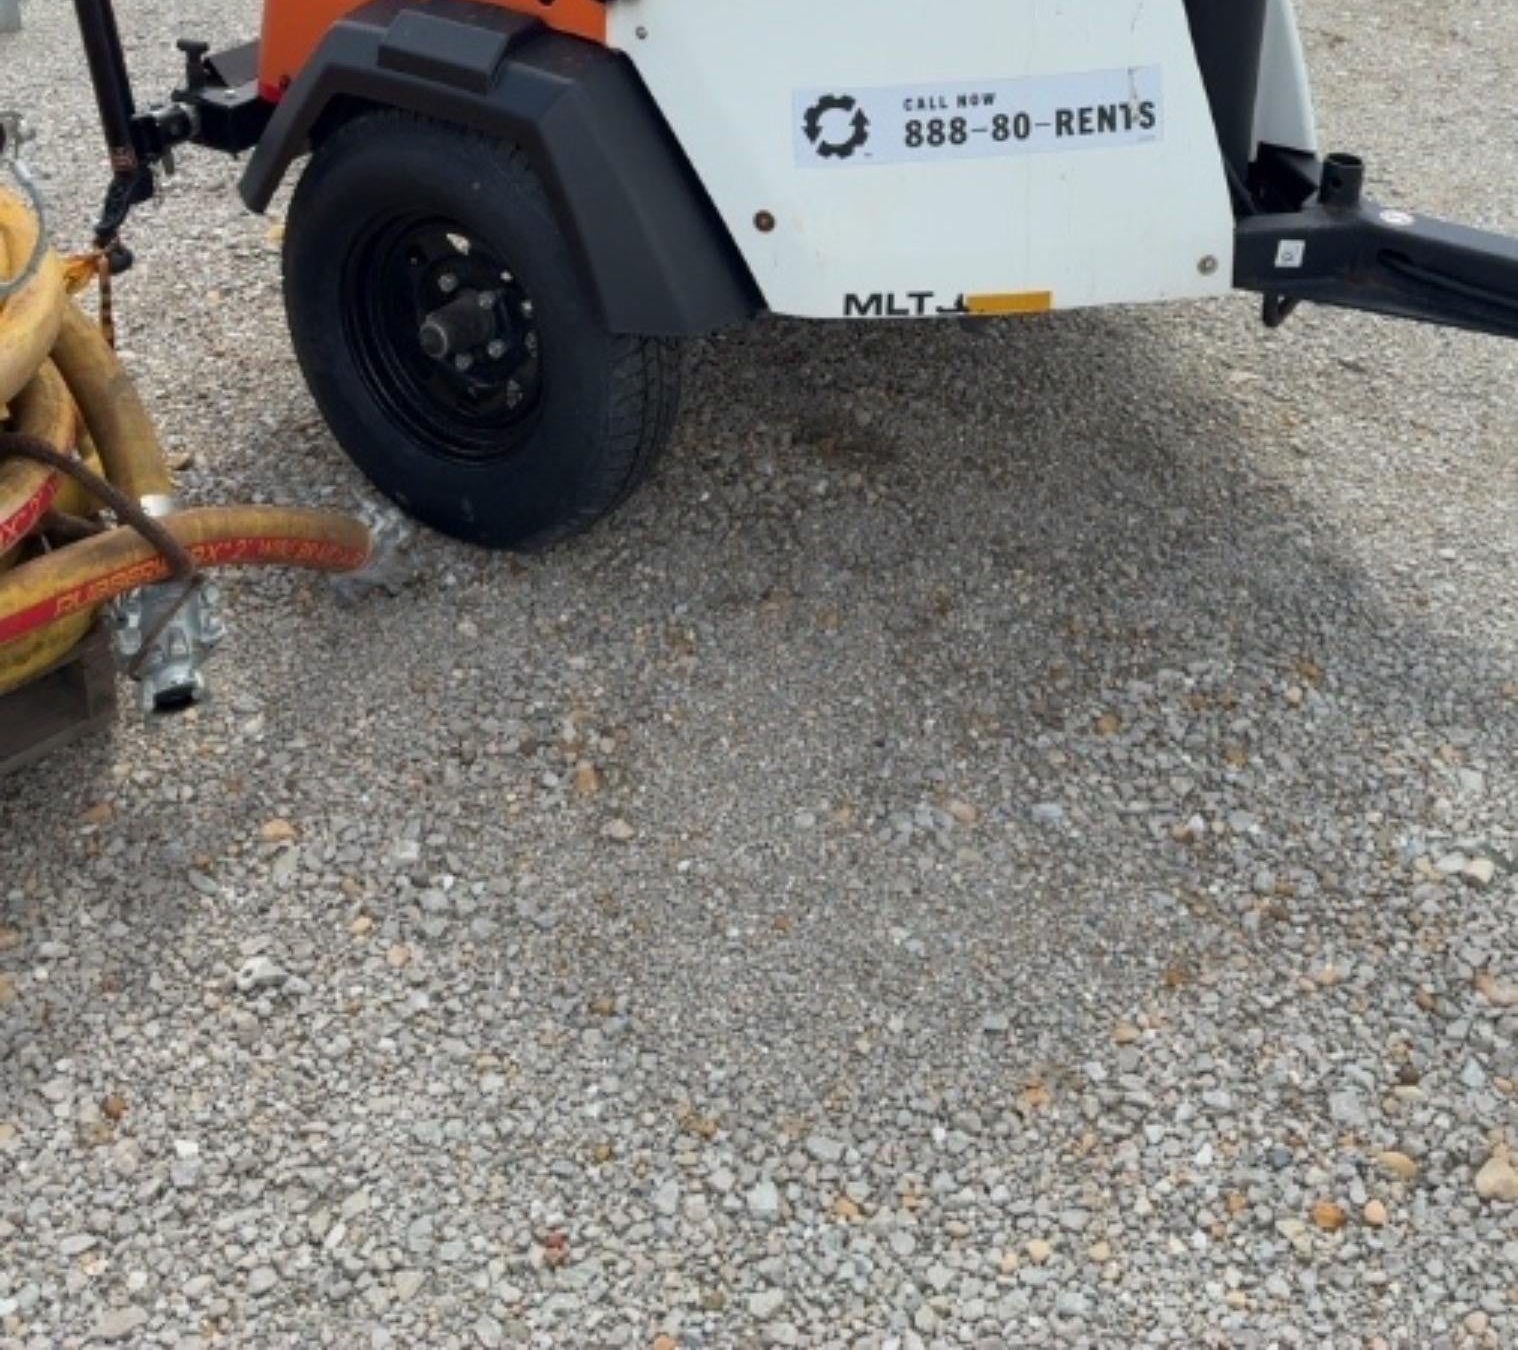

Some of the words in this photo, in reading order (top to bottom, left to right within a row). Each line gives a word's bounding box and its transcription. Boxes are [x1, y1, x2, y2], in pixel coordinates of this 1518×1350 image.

[903, 97, 948, 112] CALL
[957, 92, 997, 108] NOW
[904, 100, 1157, 149] 888-80-RENTS
